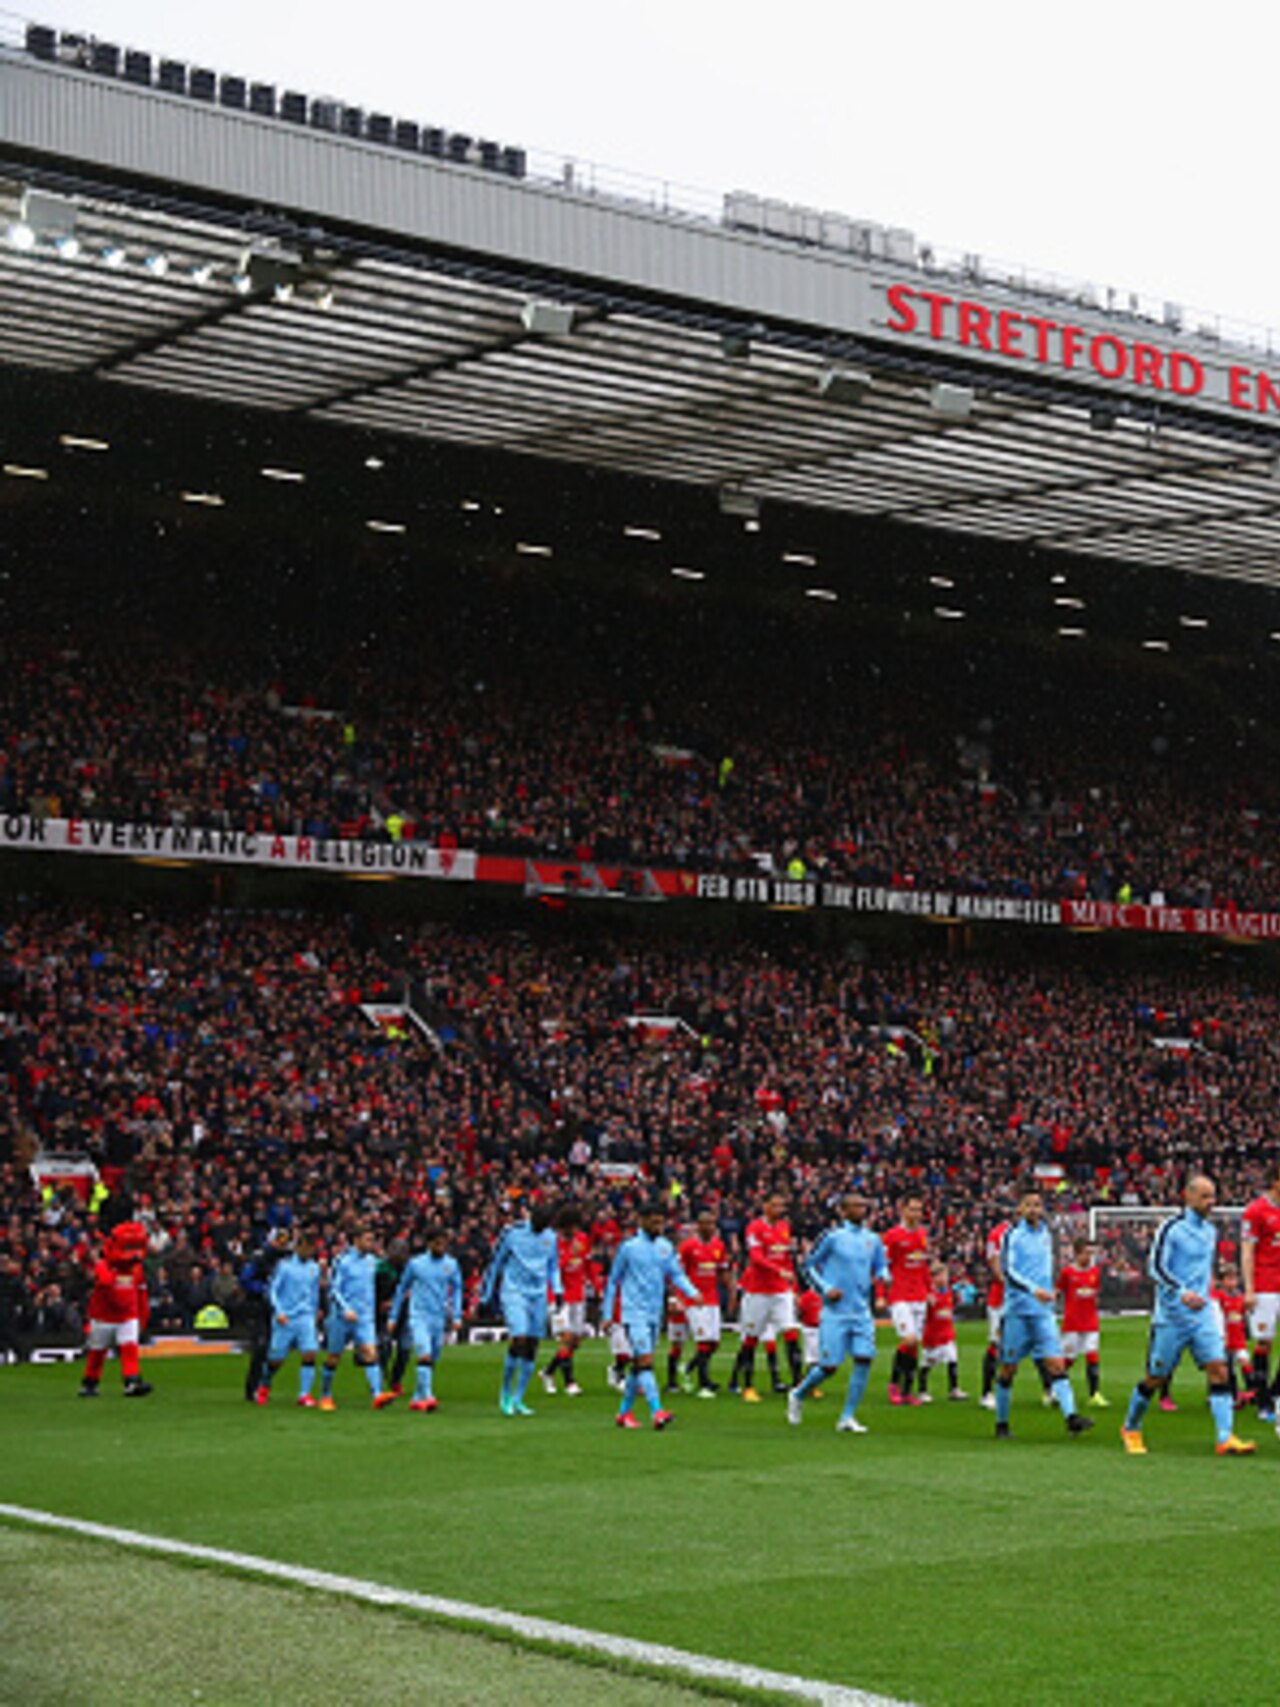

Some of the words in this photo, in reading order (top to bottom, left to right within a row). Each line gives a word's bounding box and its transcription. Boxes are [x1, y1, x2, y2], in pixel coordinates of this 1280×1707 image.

[887, 284, 1204, 395] STRETFORD
[270, 836, 285, 859] A
[297, 838, 425, 868] RELIGION
[697, 874, 727, 898] FEB
[957, 895, 1060, 924] MANCHESTER
[1144, 906, 1185, 932] THE
